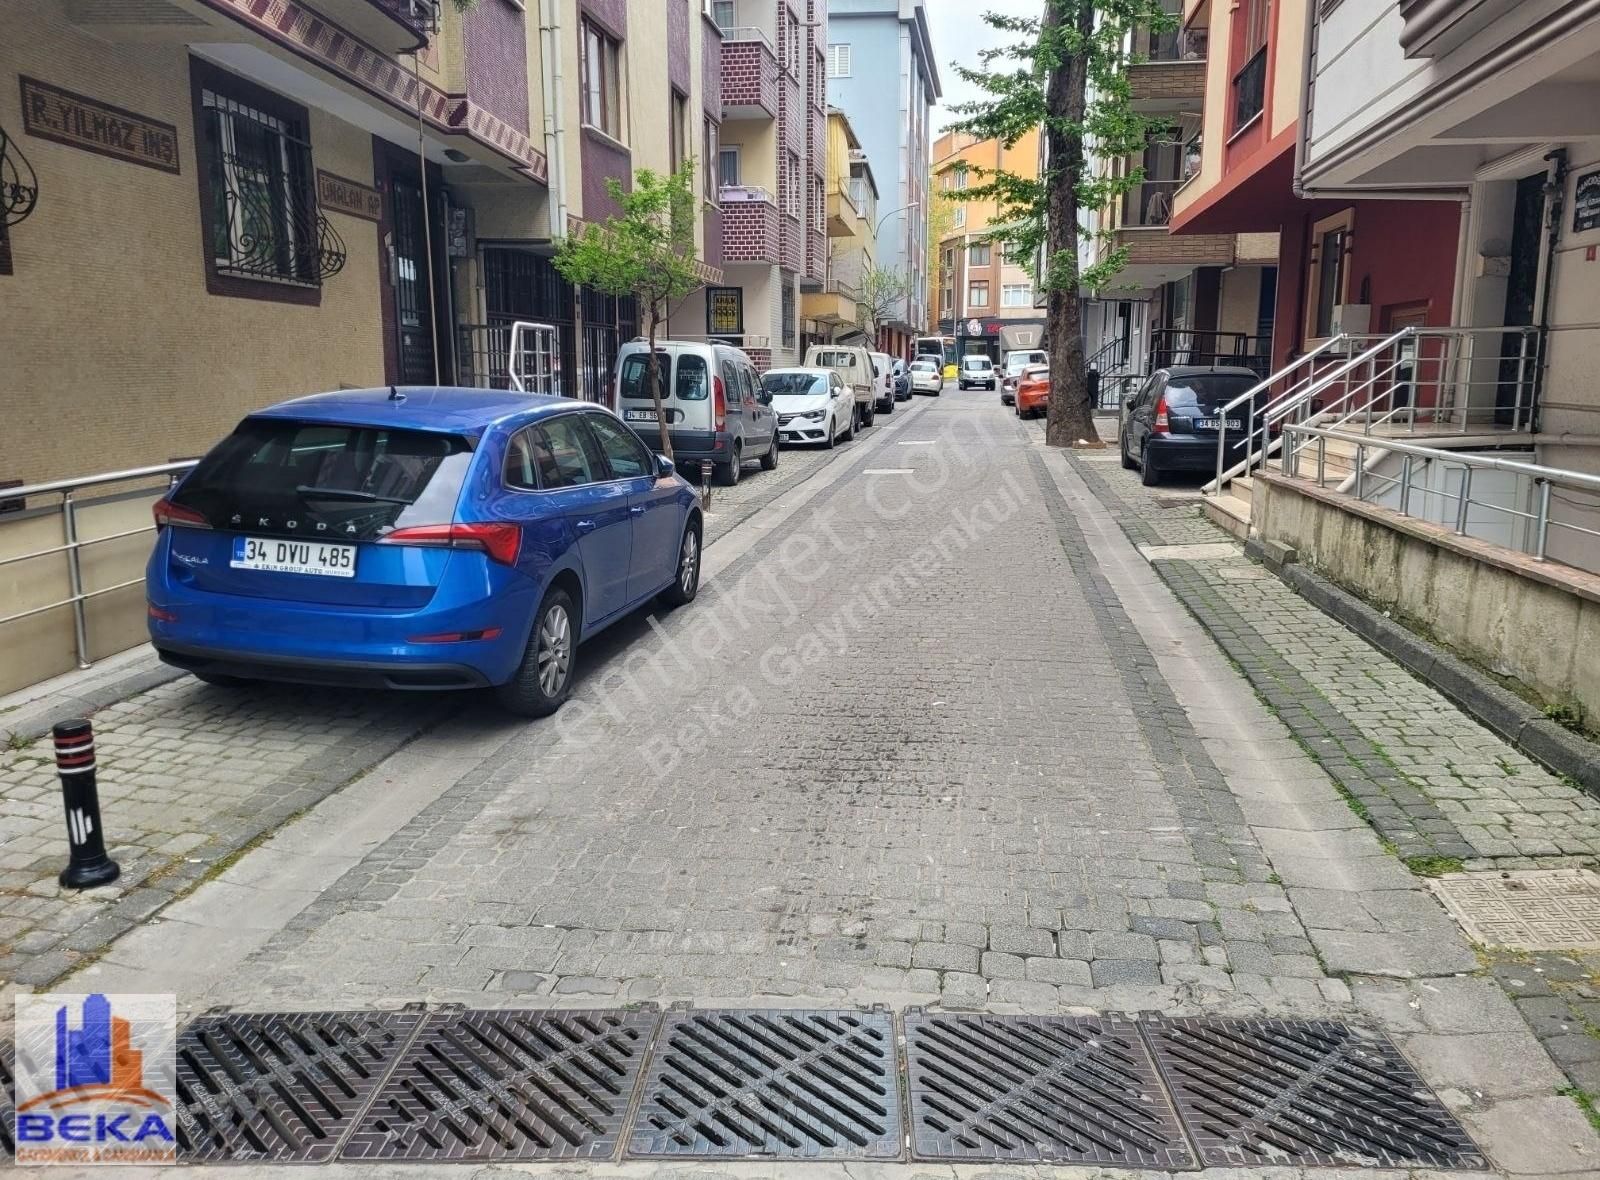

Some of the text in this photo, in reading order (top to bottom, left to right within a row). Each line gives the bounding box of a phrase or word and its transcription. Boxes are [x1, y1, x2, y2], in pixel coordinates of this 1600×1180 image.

[246, 541, 267, 561] 34
[276, 543, 310, 565] DVU
[318, 546, 351, 568] 485
